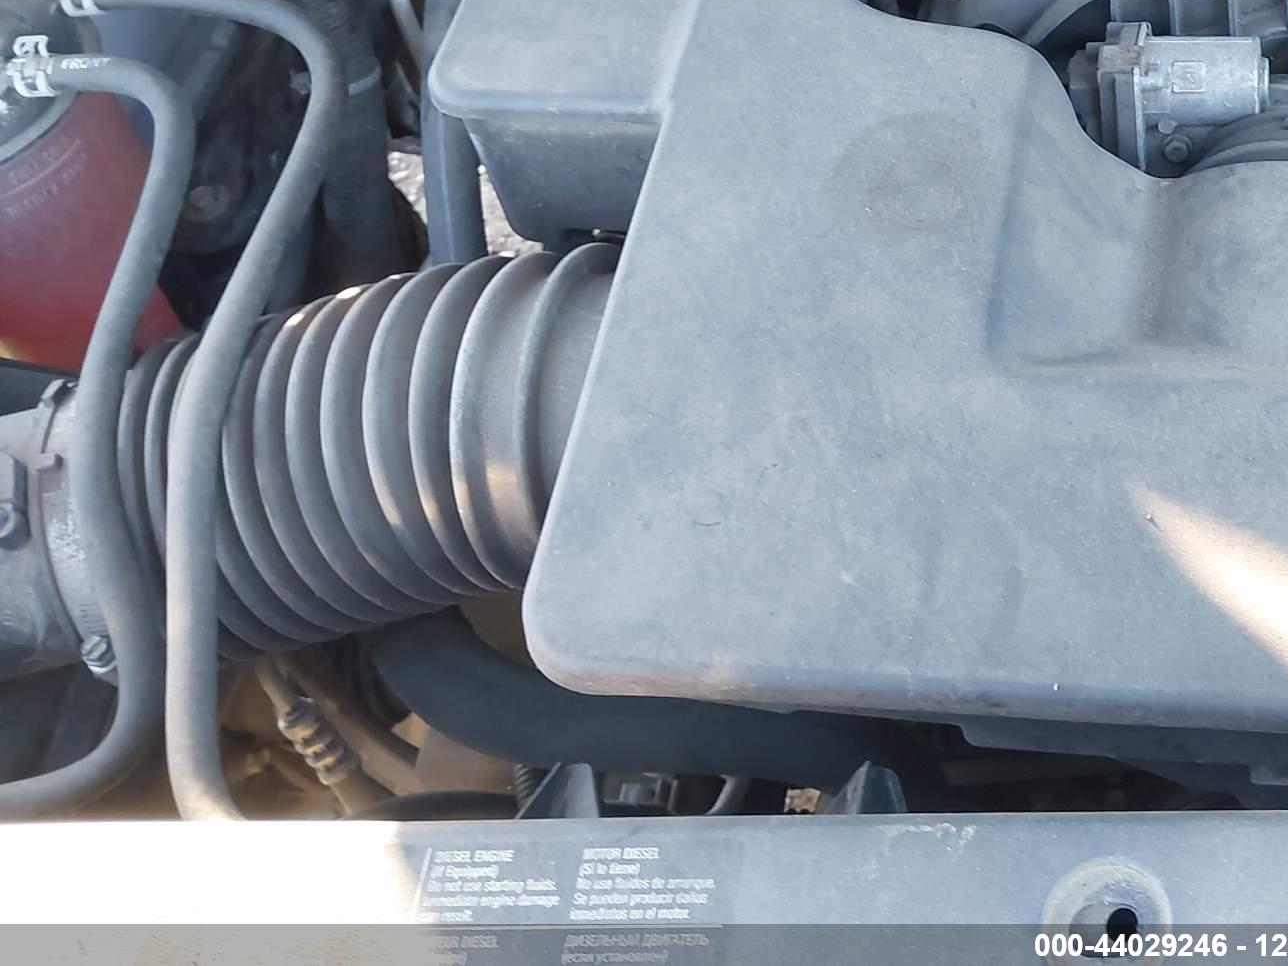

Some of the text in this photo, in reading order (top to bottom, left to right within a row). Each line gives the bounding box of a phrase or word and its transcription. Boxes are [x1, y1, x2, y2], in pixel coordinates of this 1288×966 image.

[60, 57, 112, 70] FRONT
[434, 849, 515, 862] DIESEL ENGINE
[582, 847, 622, 860] MOTOR
[445, 864, 499, 879] Equipped)
[579, 862, 641, 877] (Si lo tiene)
[427, 878, 558, 893] Do not use starting fluids.
[576, 877, 715, 890] No use fluidos de arranque.
[479, 895, 515, 908] engine
[516, 894, 561, 908] damage
[573, 892, 588, 905] Se
[588, 892, 629, 906] pueden
[629, 892, 674, 906] producir
[440, 909, 474, 922] result.
[569, 907, 690, 920] inmediatos en el motor.
[460, 935, 499, 948] DIESEL
